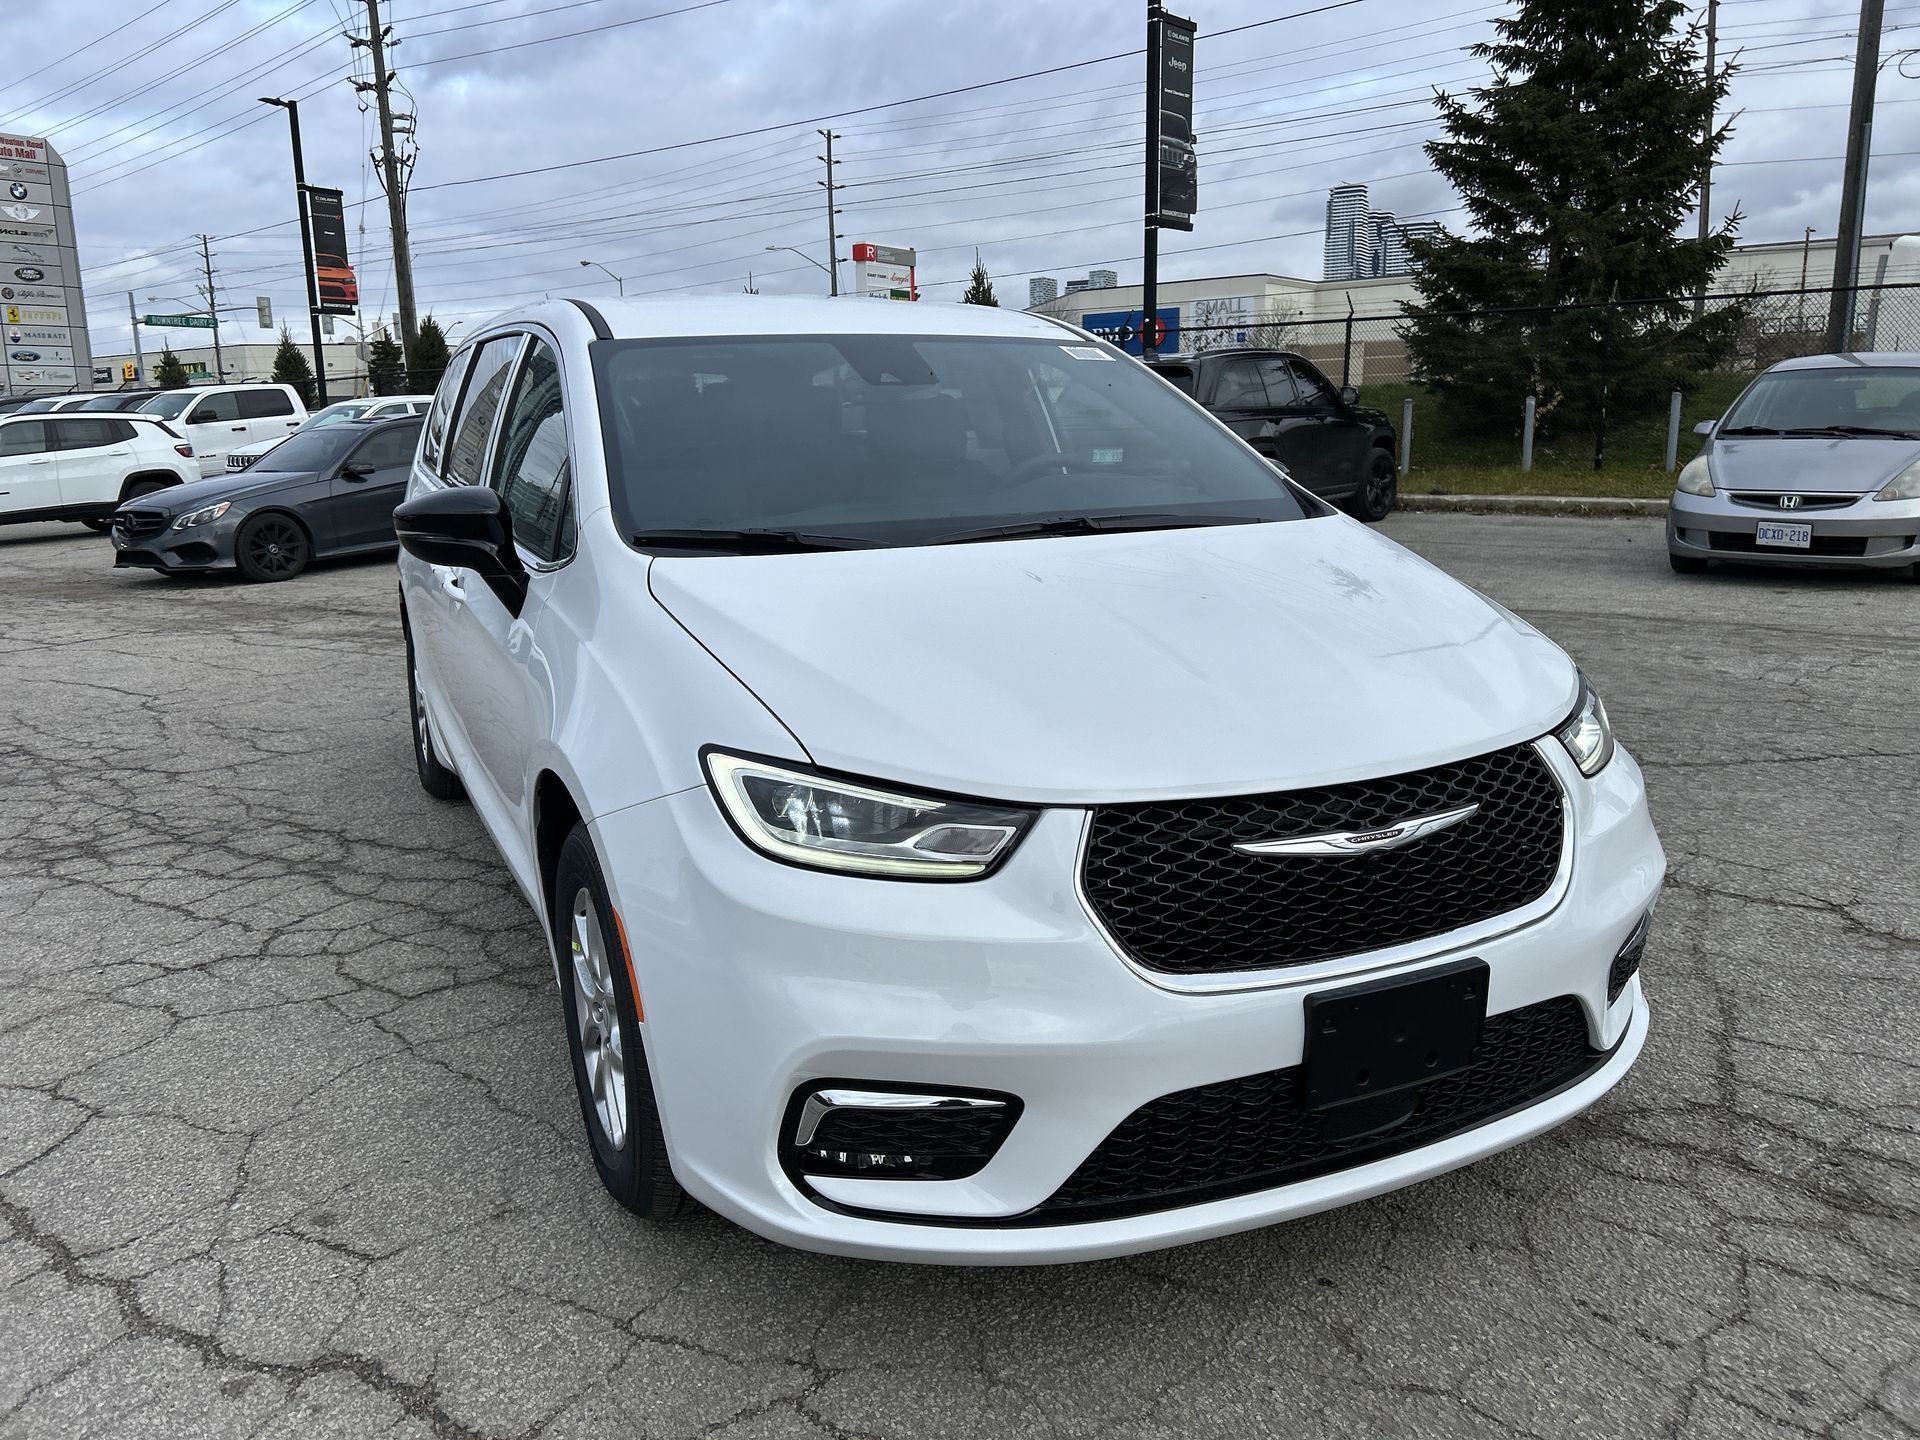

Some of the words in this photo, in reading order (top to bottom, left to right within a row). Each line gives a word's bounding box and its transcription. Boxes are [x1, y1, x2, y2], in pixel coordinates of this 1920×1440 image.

[1169, 57, 1187, 72] Jeep
[26, 140, 44, 149] Road
[0, 146, 13, 157] uto
[15, 147, 36, 159] Mall
[0, 228, 48, 238] McLaren
[866, 246, 874, 258] R
[1195, 298, 1248, 315] SMALL
[151, 316, 187, 326] ROWNTREE
[189, 318, 208, 327] DAIRY
[24, 331, 66, 340] MASERATI
[1351, 831, 1399, 842] CHRYSLER
